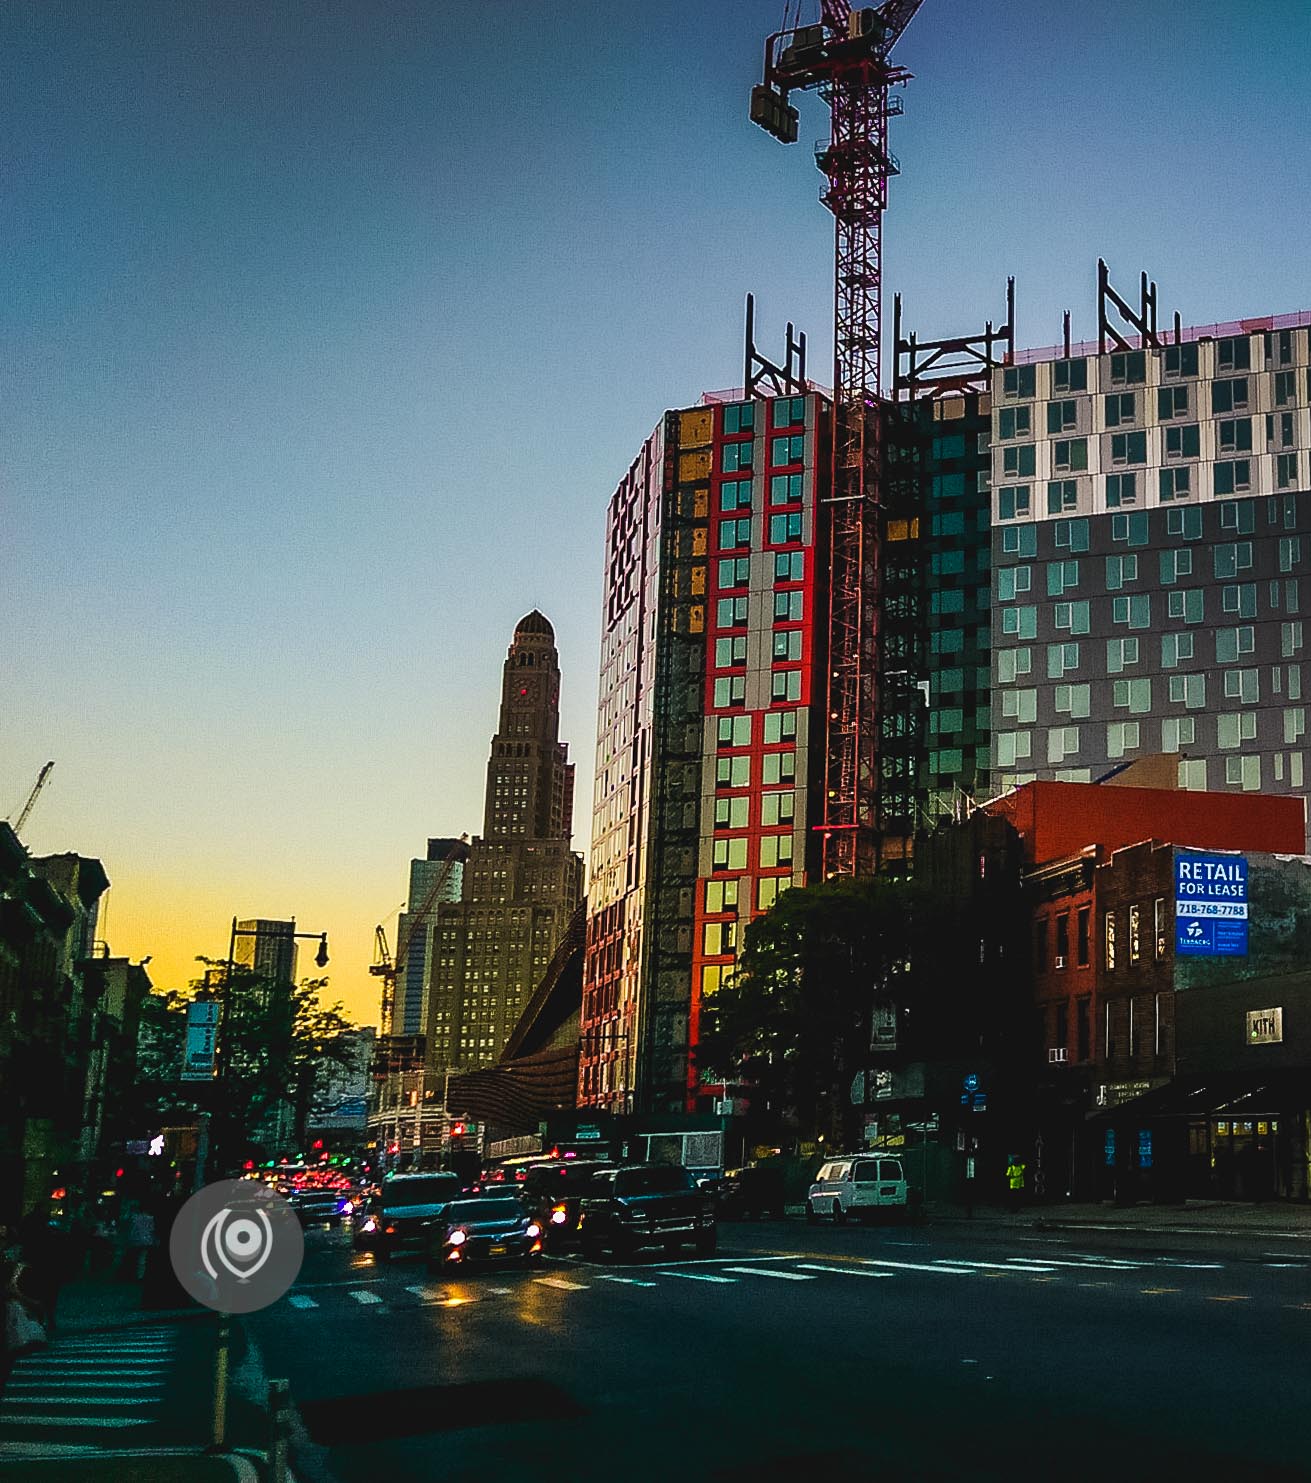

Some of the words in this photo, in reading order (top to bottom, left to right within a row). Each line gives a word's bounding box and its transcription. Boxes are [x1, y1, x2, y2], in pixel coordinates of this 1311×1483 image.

[1179, 862, 1244, 881] RETAIL
[1179, 882, 1204, 894] FOR
[1208, 884, 1244, 896] LEASE
[1253, 1016, 1275, 1036] KITH
